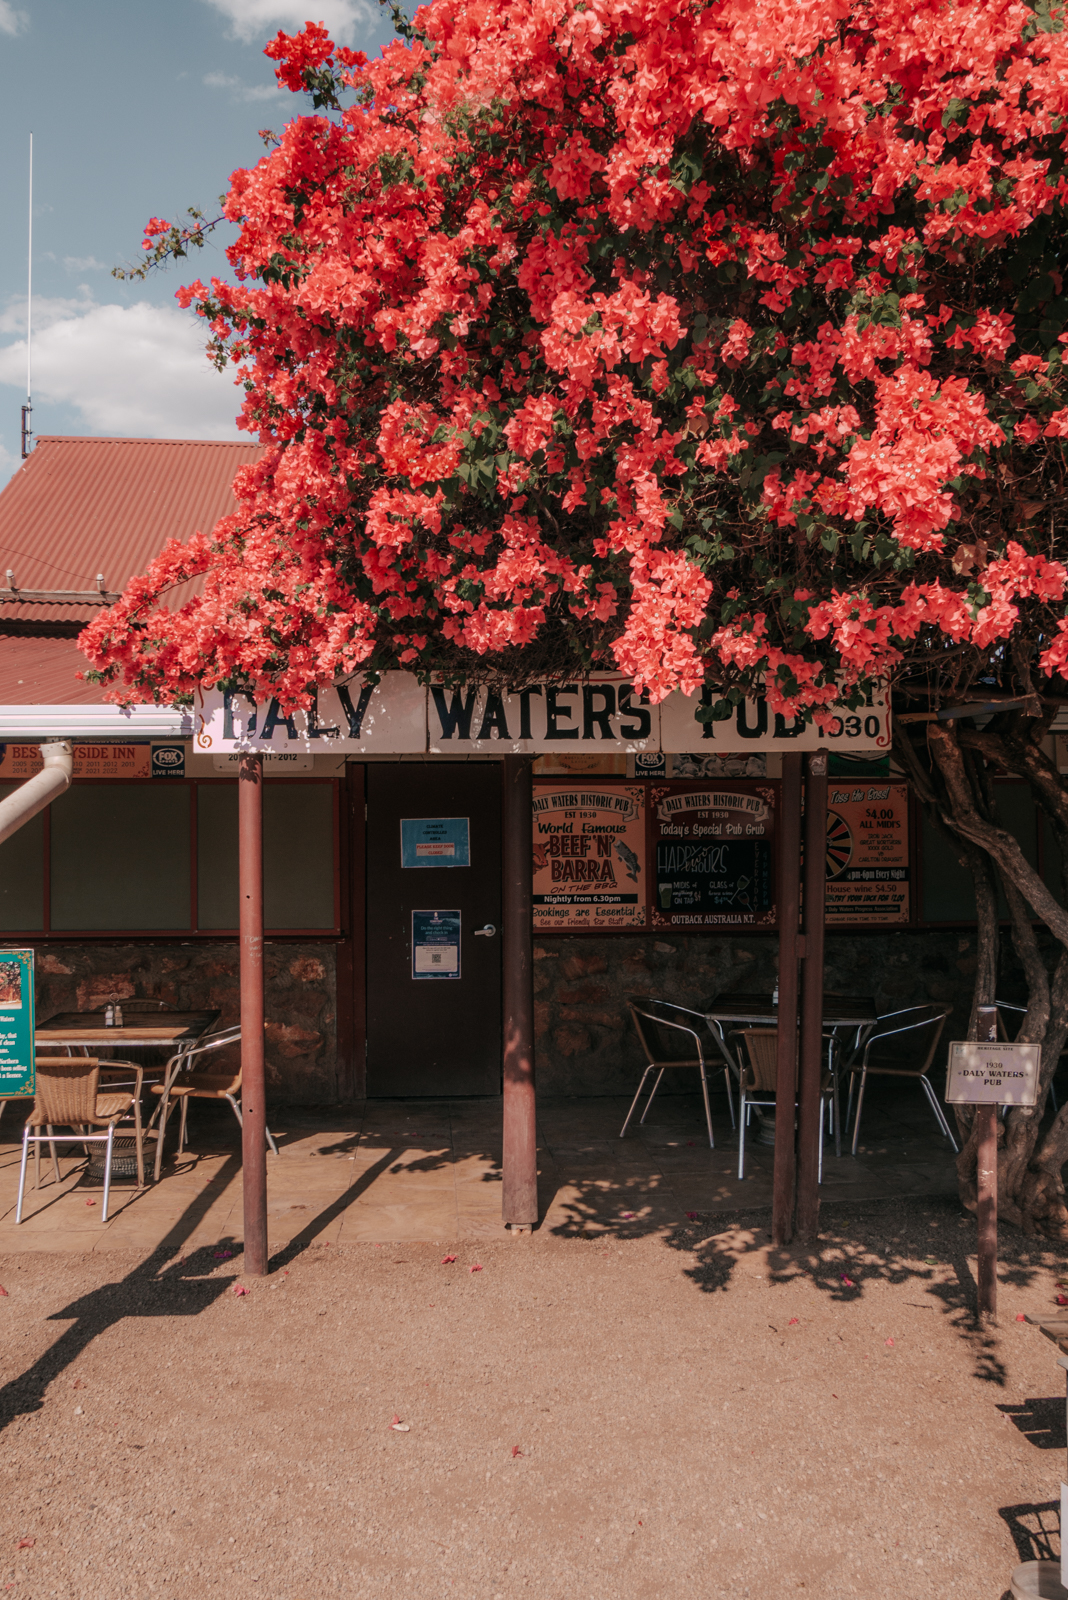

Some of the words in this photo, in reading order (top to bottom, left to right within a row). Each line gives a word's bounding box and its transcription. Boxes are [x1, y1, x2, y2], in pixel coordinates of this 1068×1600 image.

[223, 684, 377, 740] DALY
[430, 683, 652, 740] WATERS
[113, 747, 135, 758] INN
[831, 790, 850, 804] Toss
[852, 789, 865, 802] the
[867, 786, 891, 801] Boss!
[533, 798, 549, 812] DALY
[551, 794, 578, 807] WATERS
[581, 794, 612, 808] HISTORIC
[614, 798, 629, 811] PUB
[666, 798, 682, 812] DALY
[684, 795, 710, 808] WATERS
[714, 795, 744, 808] HISTORIC
[746, 798, 760, 812] PUB
[866, 808, 893, 819] $4.00
[538, 823, 573, 834] World
[582, 823, 627, 833] Famous
[660, 822, 689, 837] Today's
[692, 823, 722, 837] Special
[726, 823, 742, 835] Pub
[746, 823, 765, 835] Grub
[550, 835, 590, 857] BEEF
[658, 846, 702, 873] HAPPY
[551, 860, 614, 882] BARRA
[876, 870, 890, 880] Every
[891, 870, 905, 880] Night
[551, 885, 566, 893] ON
[569, 884, 592, 892] THE
[594, 882, 618, 890] BBQ
[709, 881, 728, 889] GLASS
[876, 884, 896, 892] $4.50
[596, 906, 635, 916] Essential
[568, 918, 590, 926] Friendly
[671, 915, 702, 924] OUTBACK
[704, 915, 742, 924] AUSTRALIA
[743, 915, 756, 923] N.T.
